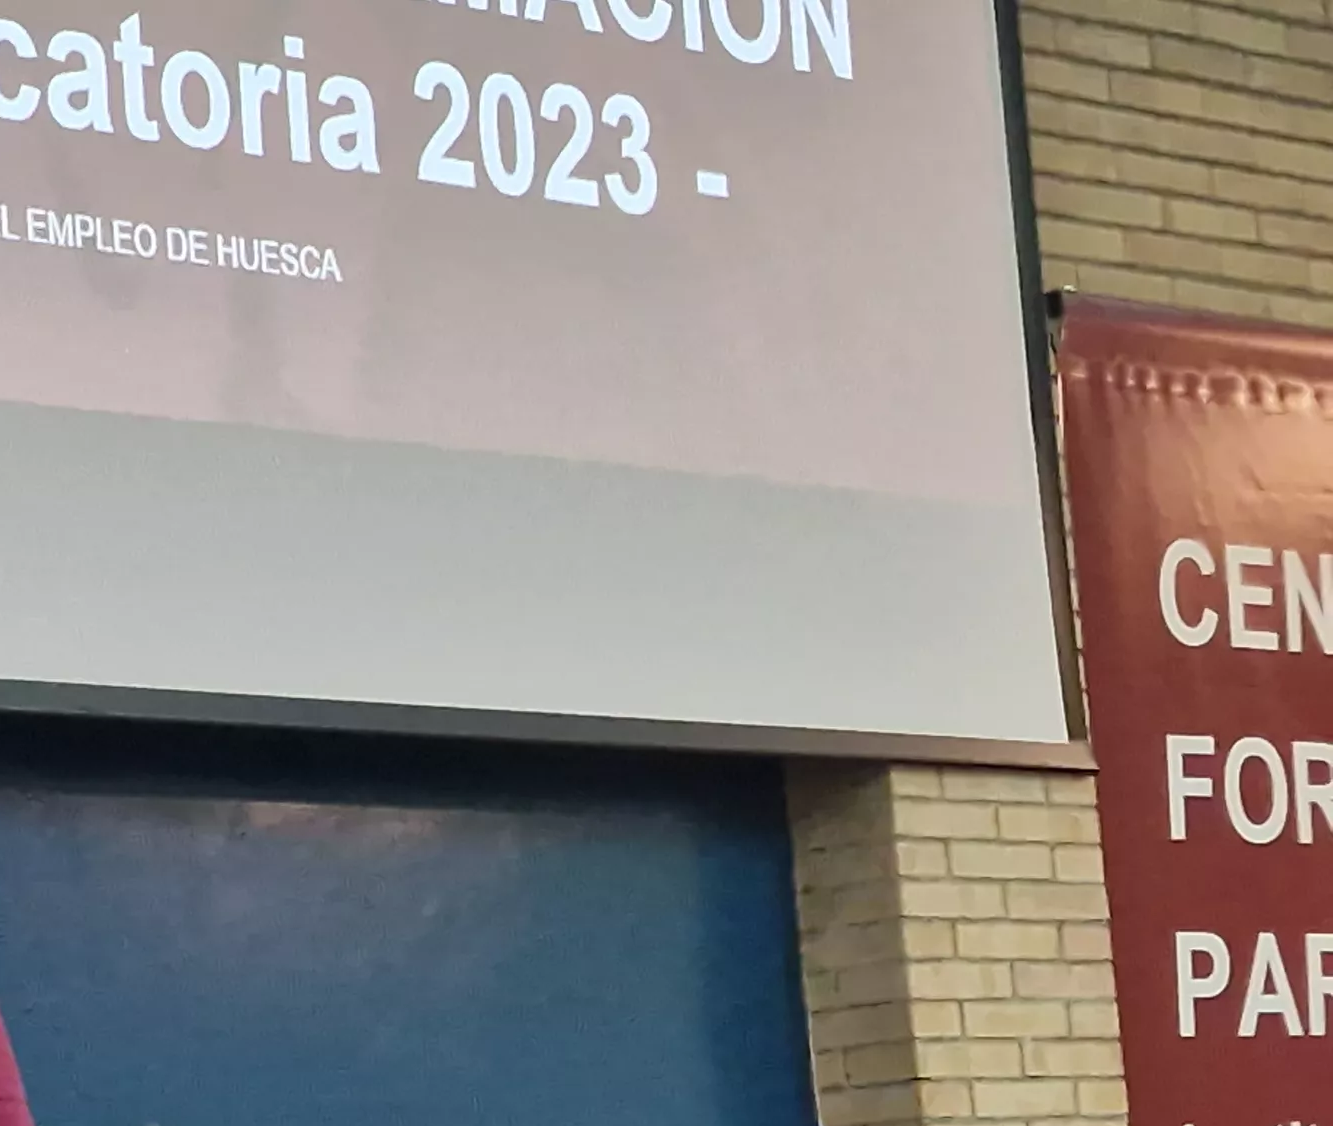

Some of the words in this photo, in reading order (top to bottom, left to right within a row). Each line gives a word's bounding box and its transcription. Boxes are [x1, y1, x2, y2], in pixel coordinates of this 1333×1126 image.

[413, 60, 659, 215] 2023
[26, 207, 157, 259] EMPLEO
[166, 226, 210, 266] DE
[216, 234, 343, 281] HUESCA
[1159, 538, 1333, 654] CEN
[1166, 734, 1333, 844] FOR
